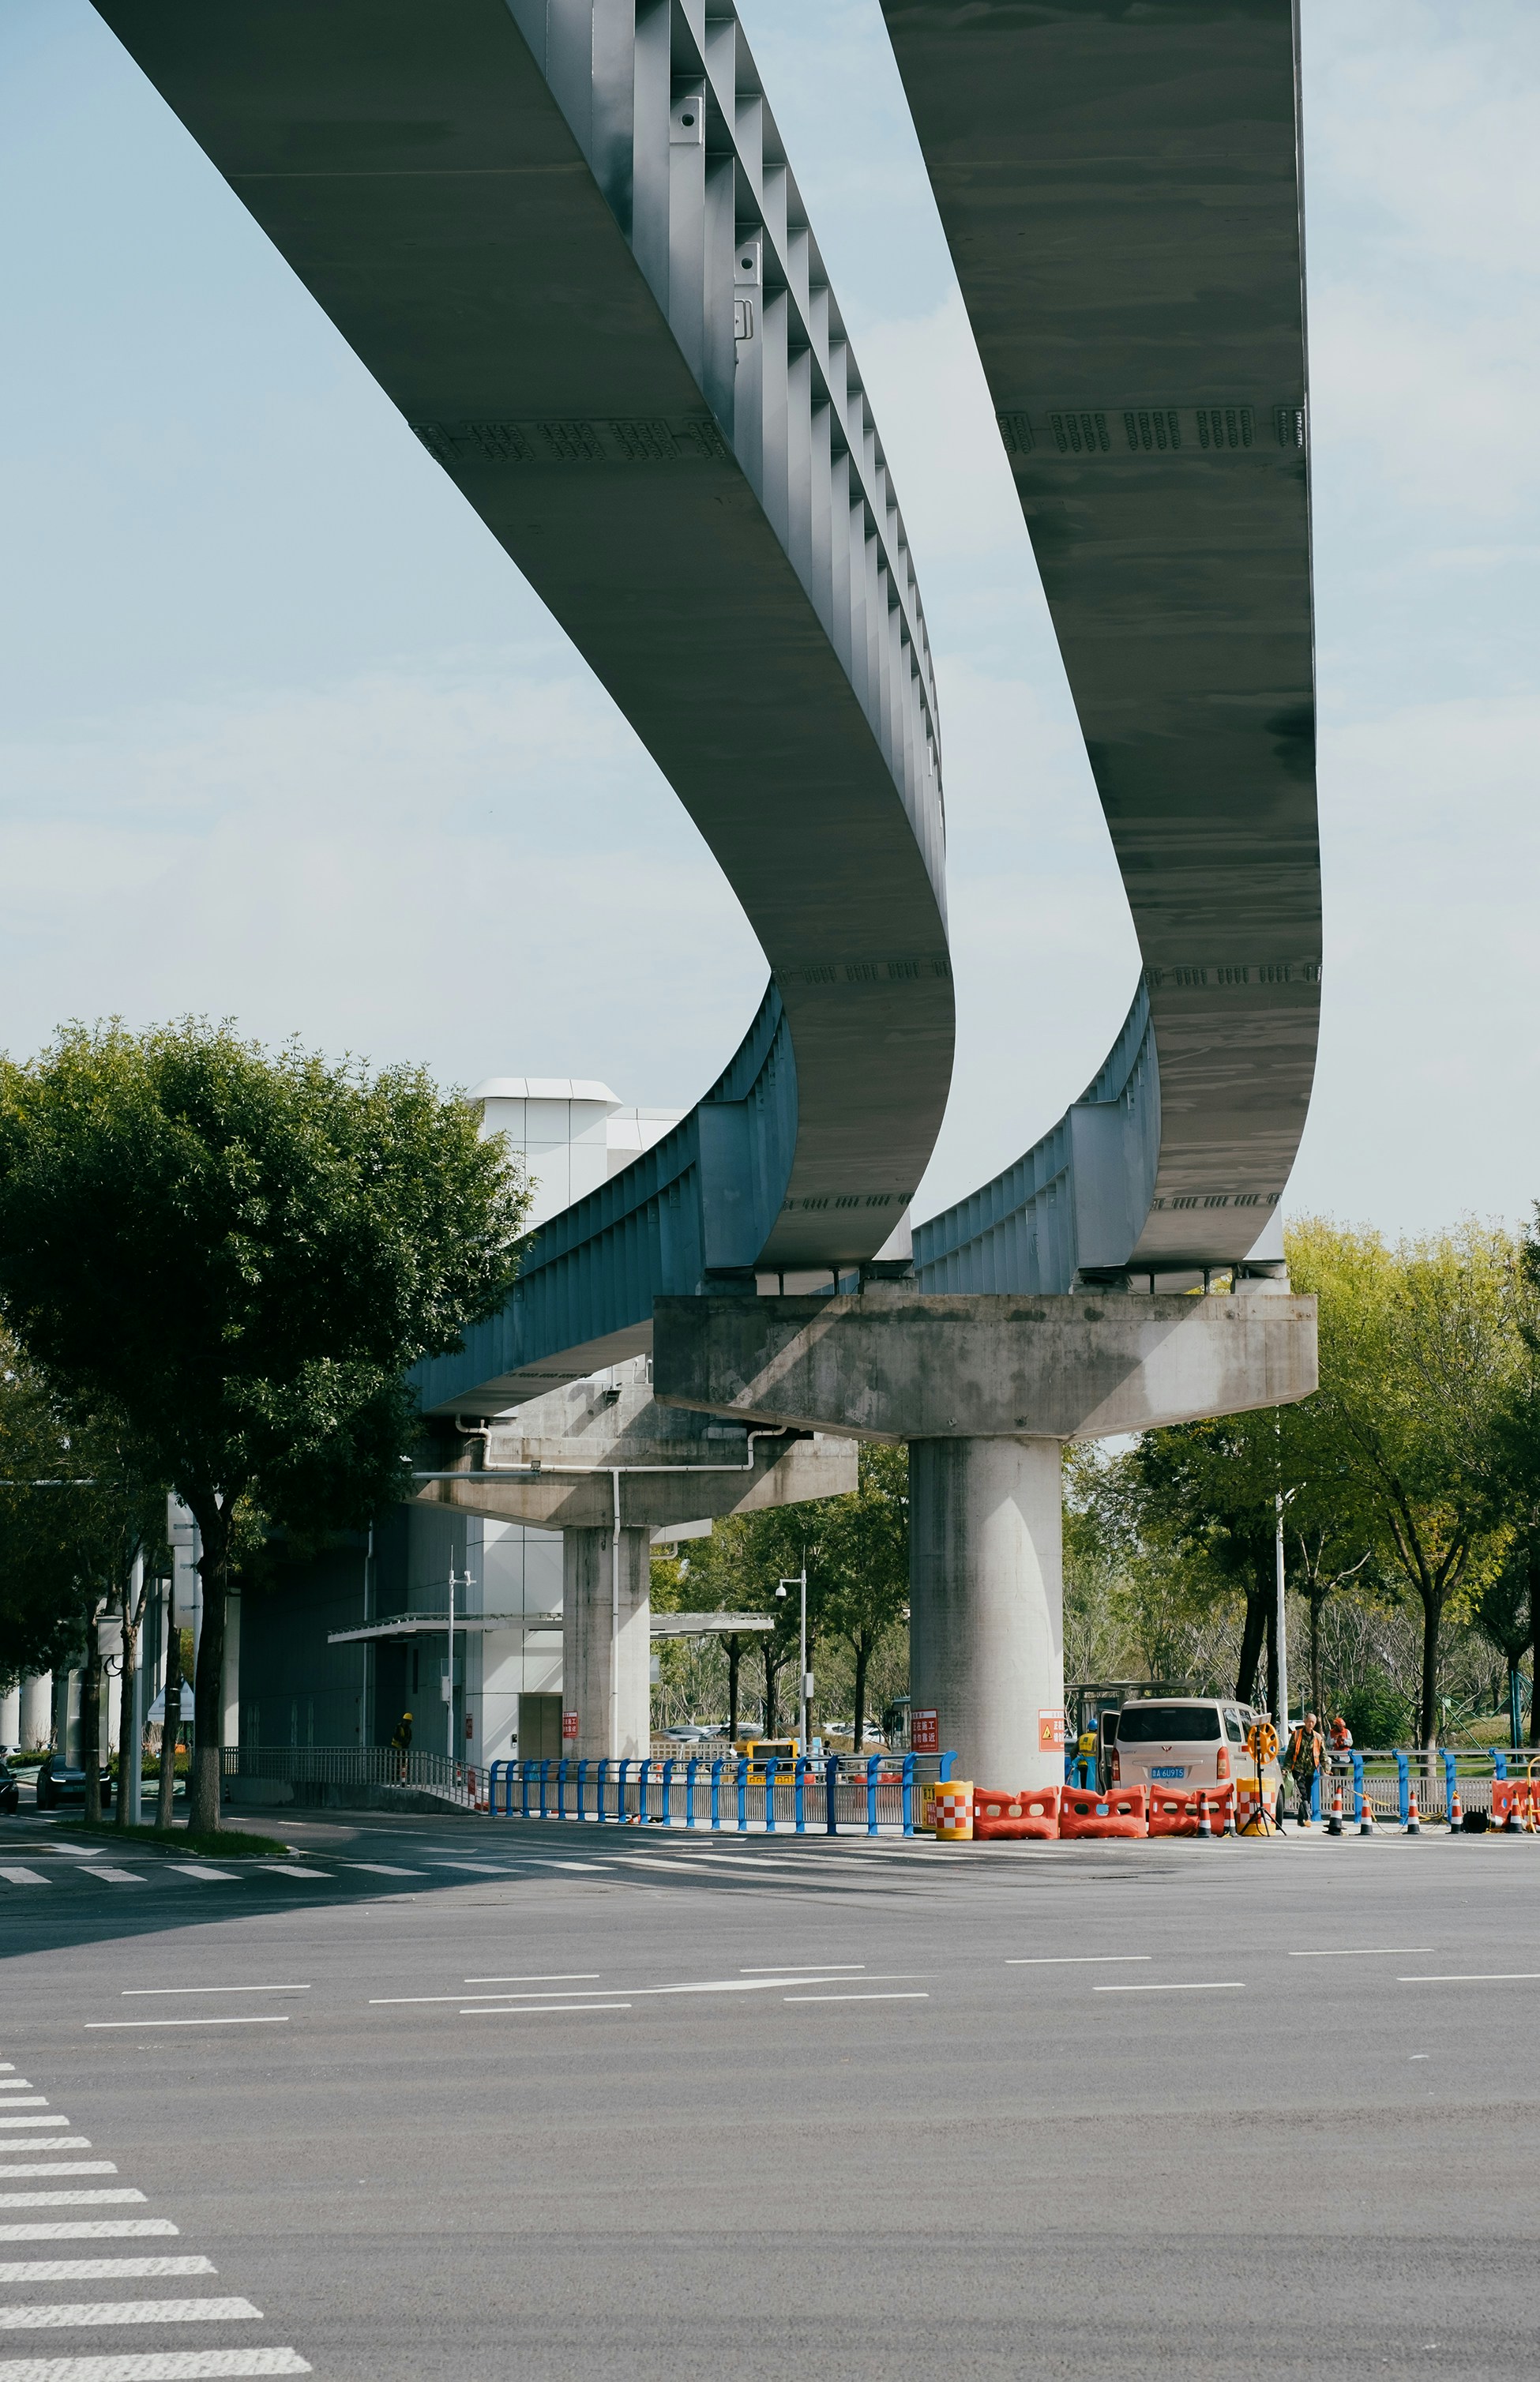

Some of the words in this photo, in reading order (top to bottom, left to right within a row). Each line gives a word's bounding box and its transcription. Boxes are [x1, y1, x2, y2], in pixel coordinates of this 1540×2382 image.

[913, 1721, 935, 1730] 正在施工
[913, 1733, 935, 1743] 请勿靠近
